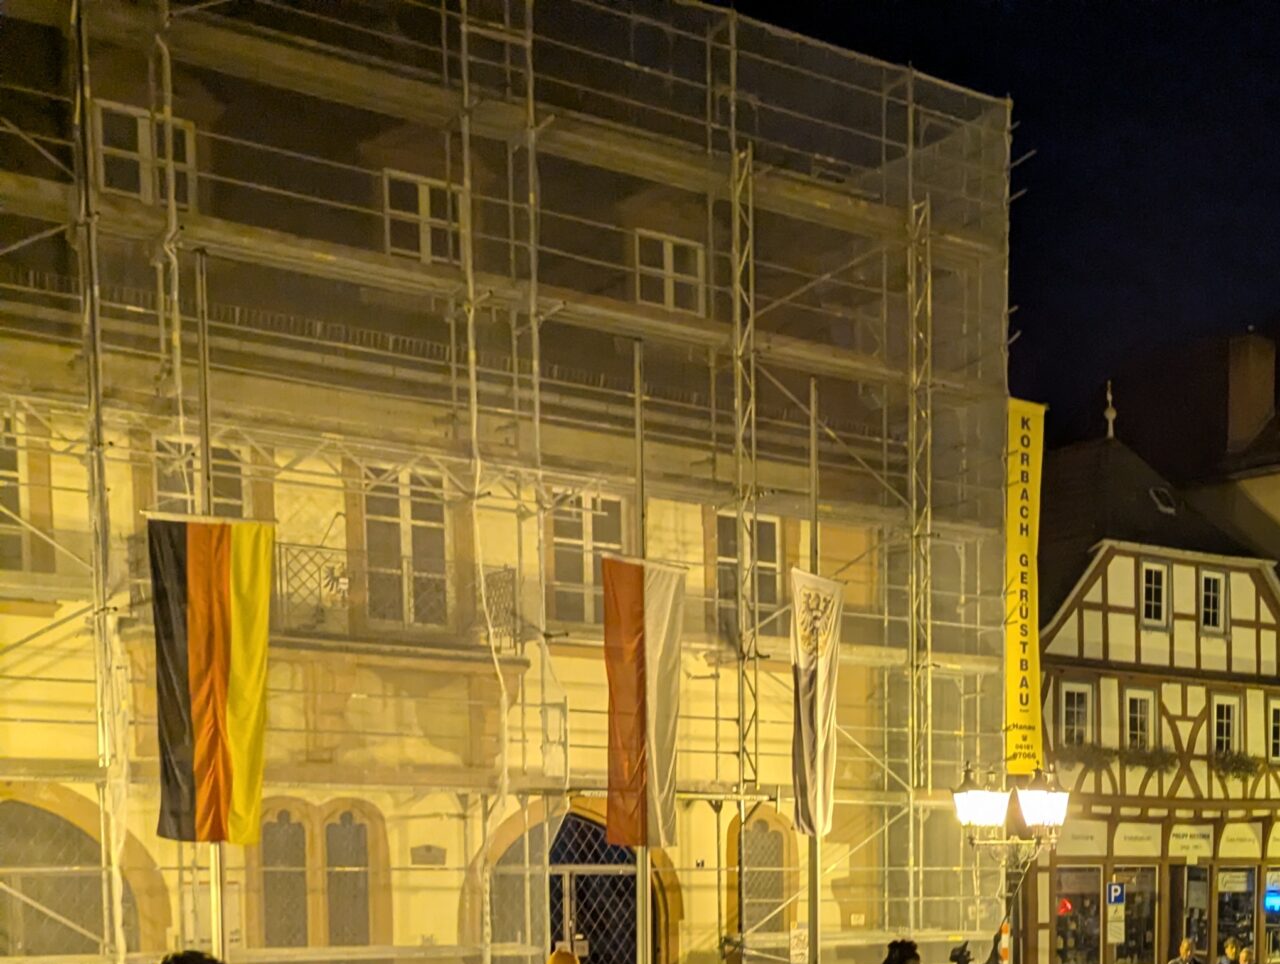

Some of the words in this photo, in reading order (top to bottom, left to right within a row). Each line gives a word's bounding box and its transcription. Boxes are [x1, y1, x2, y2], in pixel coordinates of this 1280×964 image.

[1019, 415, 1031, 537] KORBACH
[1018, 553, 1030, 706] GERÜSTBAU
[1110, 885, 1122, 903] P
